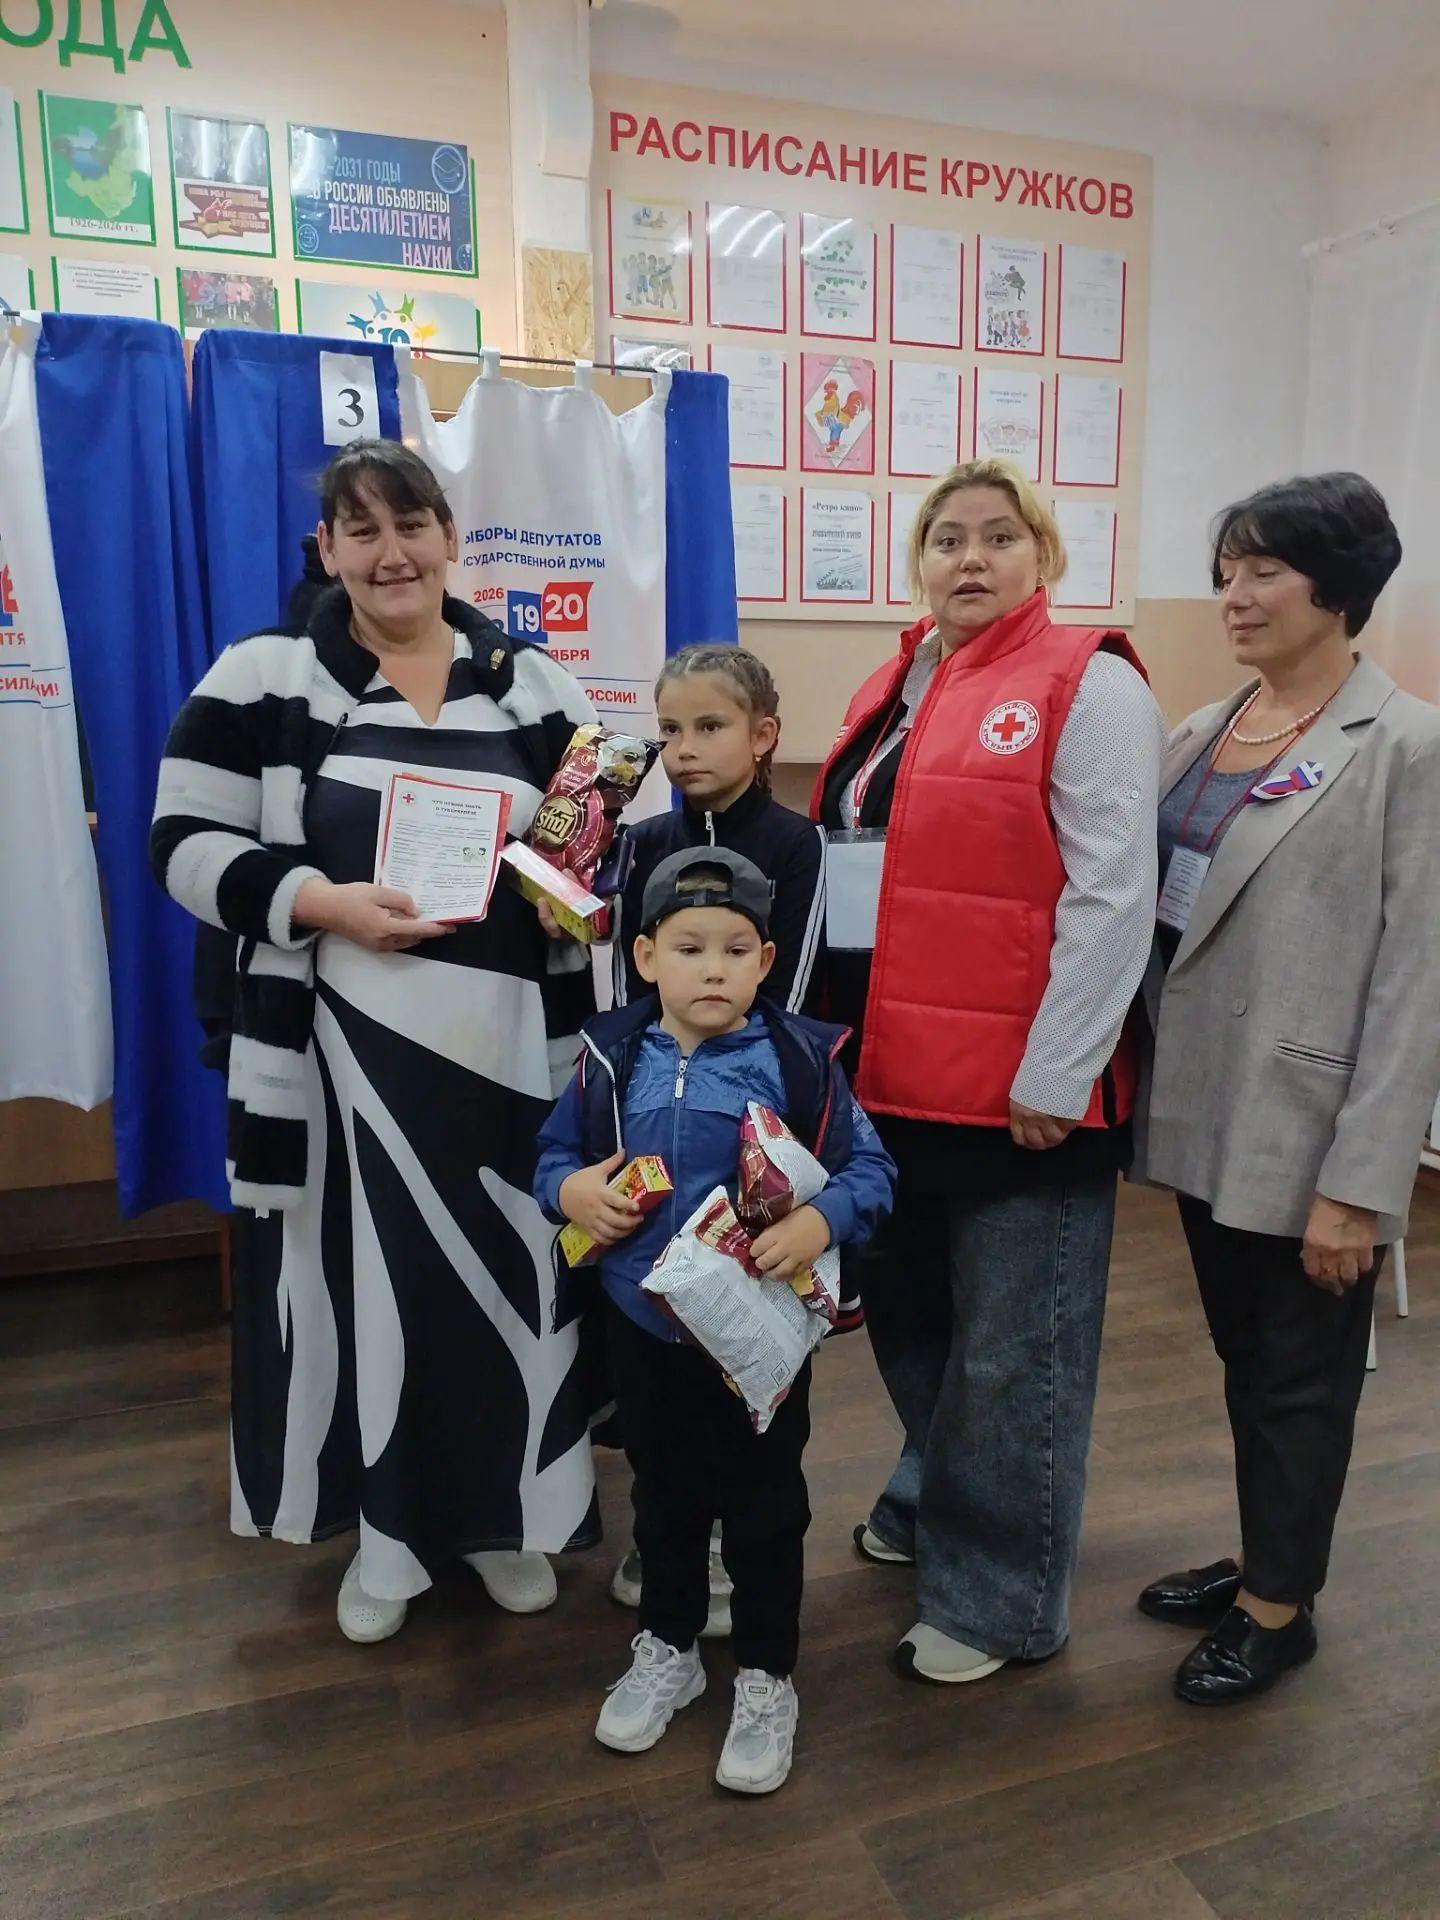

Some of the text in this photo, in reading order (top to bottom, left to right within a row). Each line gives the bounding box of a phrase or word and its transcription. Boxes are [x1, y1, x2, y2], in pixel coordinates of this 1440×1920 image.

[366, 160, 401, 185] ГОДЫ
[609, 111, 1135, 219] РАСПИСАНИЕ КРУЖКОВ
[324, 180, 374, 205] РОССИИ
[377, 185, 450, 214] ОБЪЯВЛЕНЫ
[70, 217, 122, 232] 1926-2026
[329, 203, 451, 242] ДЕСЯТИЛЕТИЕМ
[402, 242, 452, 270] НАУКИ
[338, 388, 365, 428] 3
[465, 527, 602, 547] ЫБОРЫ ДЕПУТАТОВ
[463, 552, 606, 570] СУДАРСТВЕННОЙ ДУМЫ
[474, 587, 505, 603] 2026
[512, 603, 540, 633] 19
[545, 593, 584, 621] 20
[546, 649, 590, 662] ЯБРЯ
[585, 688, 637, 704] ОССИИ!
